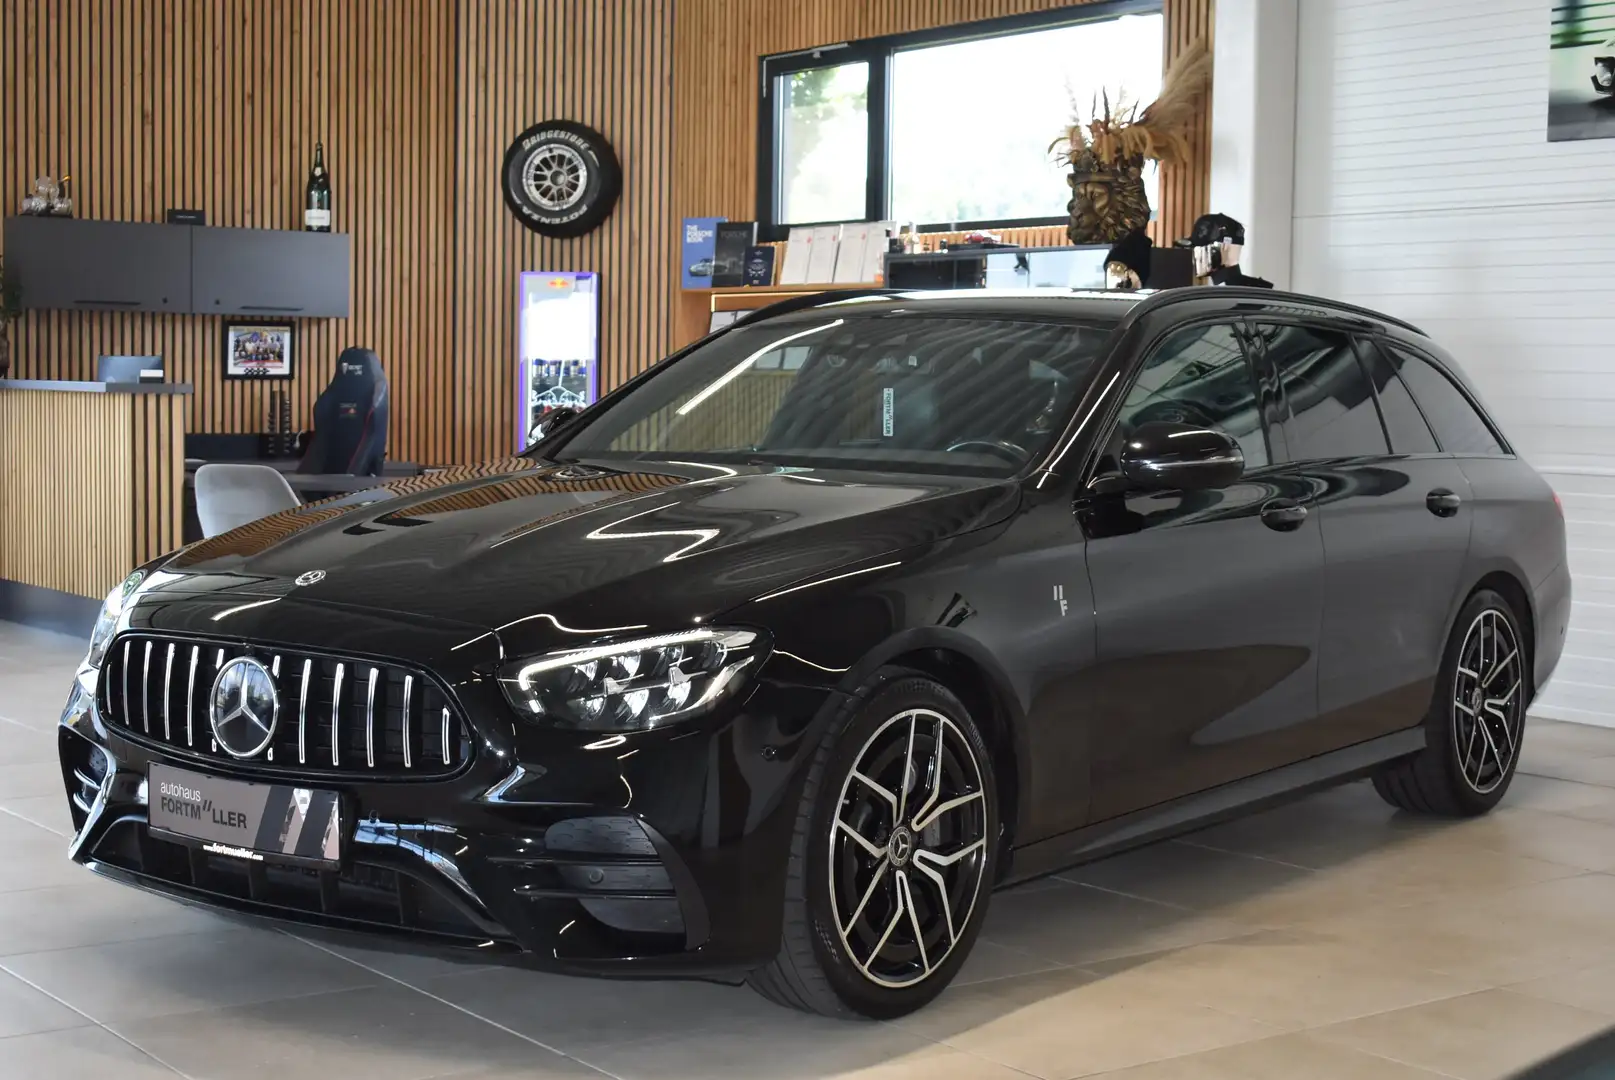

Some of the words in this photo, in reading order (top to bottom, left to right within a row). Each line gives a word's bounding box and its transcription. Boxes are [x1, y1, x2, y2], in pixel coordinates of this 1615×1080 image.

[522, 129, 590, 152] BRIDGESTONE
[522, 203, 588, 225] POTENZA
[160, 781, 201, 802] autohaus
